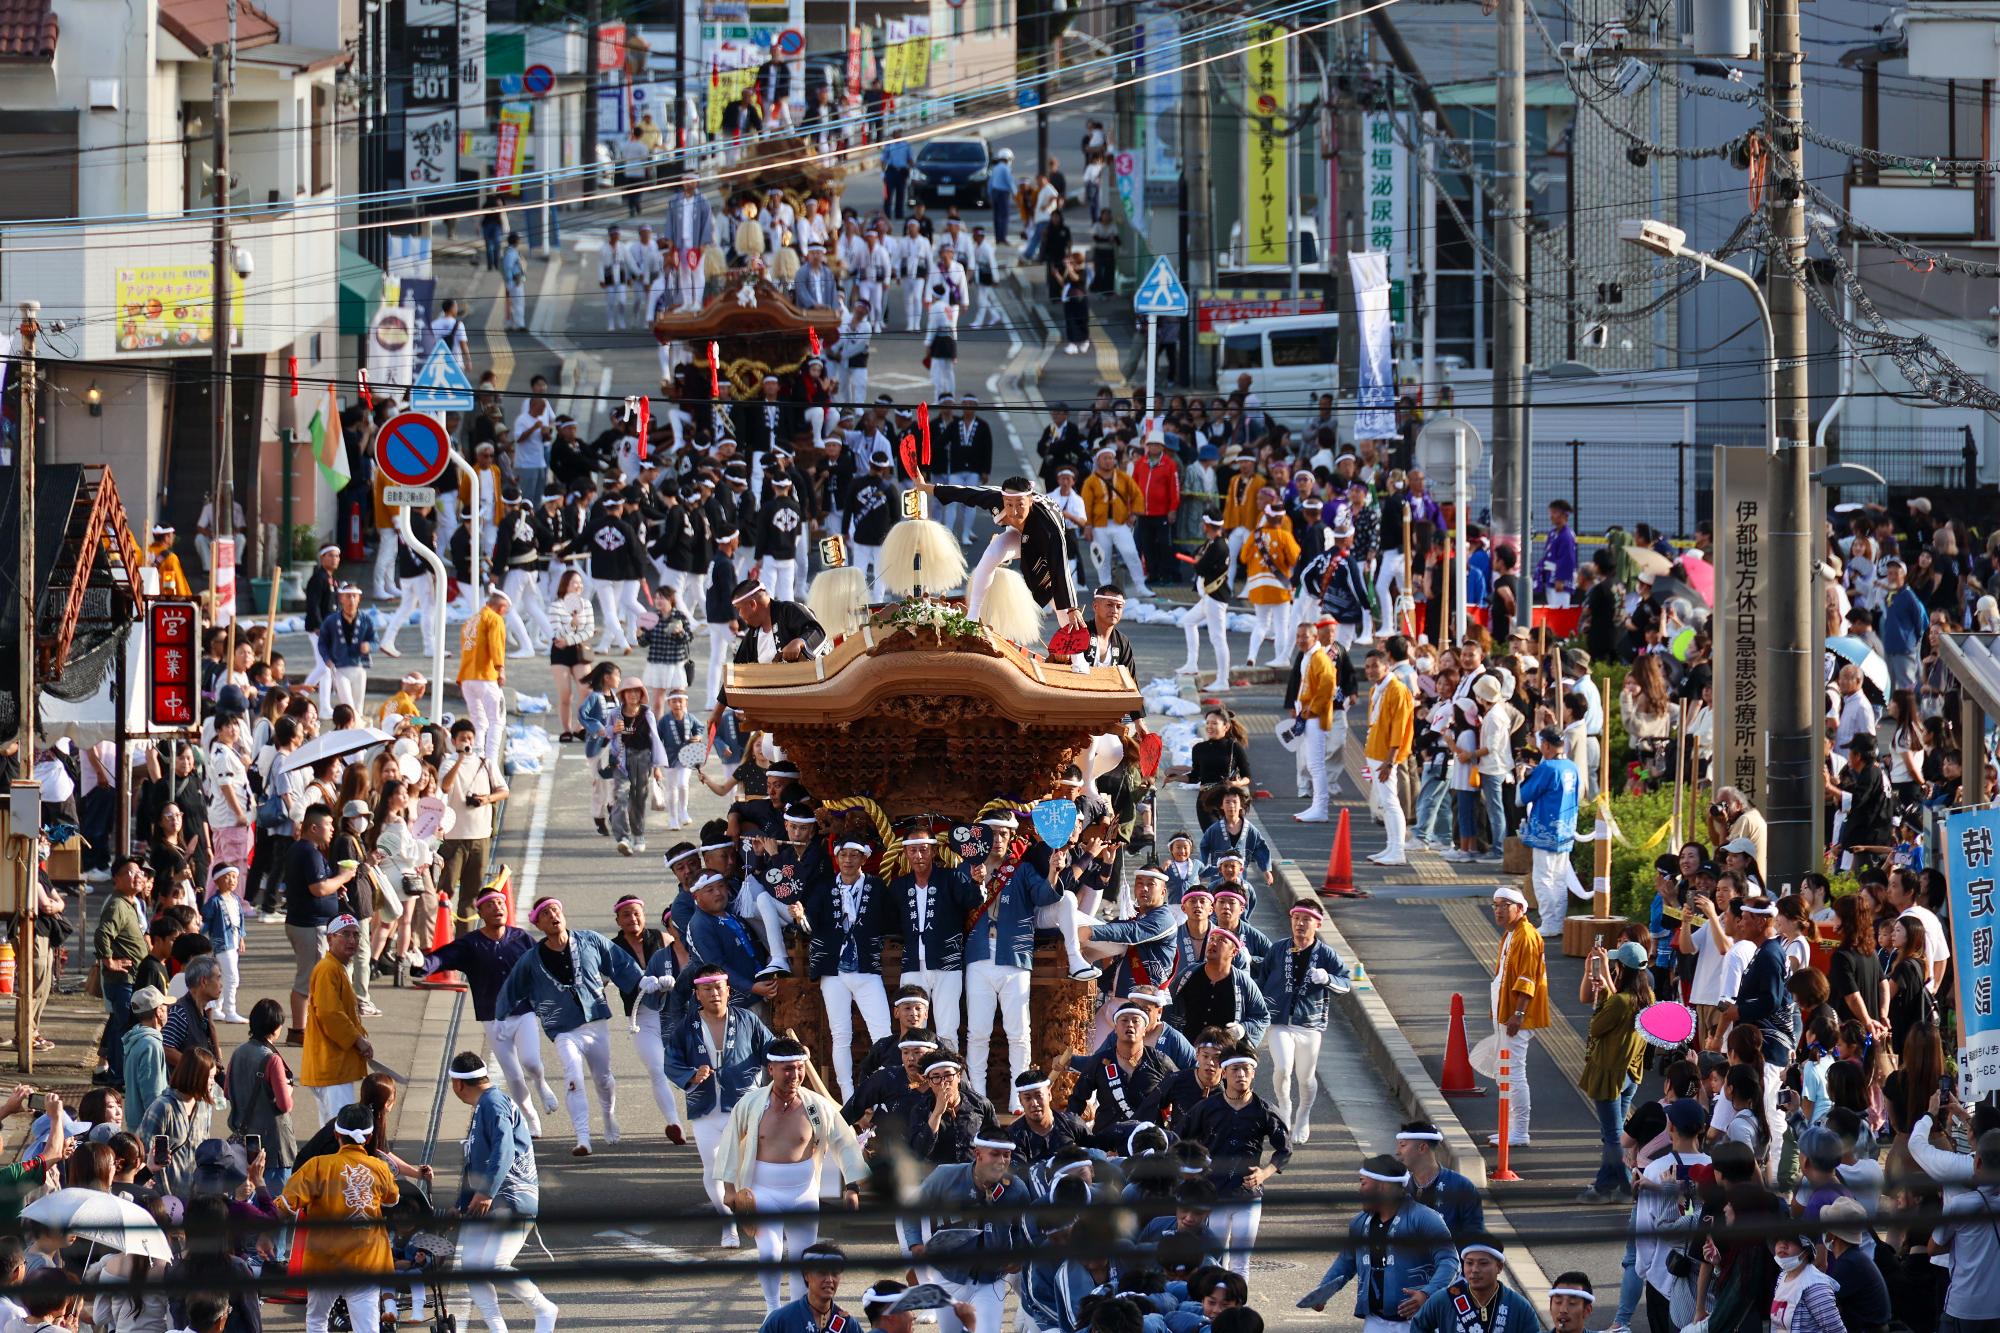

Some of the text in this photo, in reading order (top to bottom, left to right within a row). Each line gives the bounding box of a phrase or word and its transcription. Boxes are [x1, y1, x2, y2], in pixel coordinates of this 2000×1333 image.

[413, 77, 449, 99] 501
[126, 283, 203, 297] アジアンキッチン
[162, 609, 187, 717] 営業中
